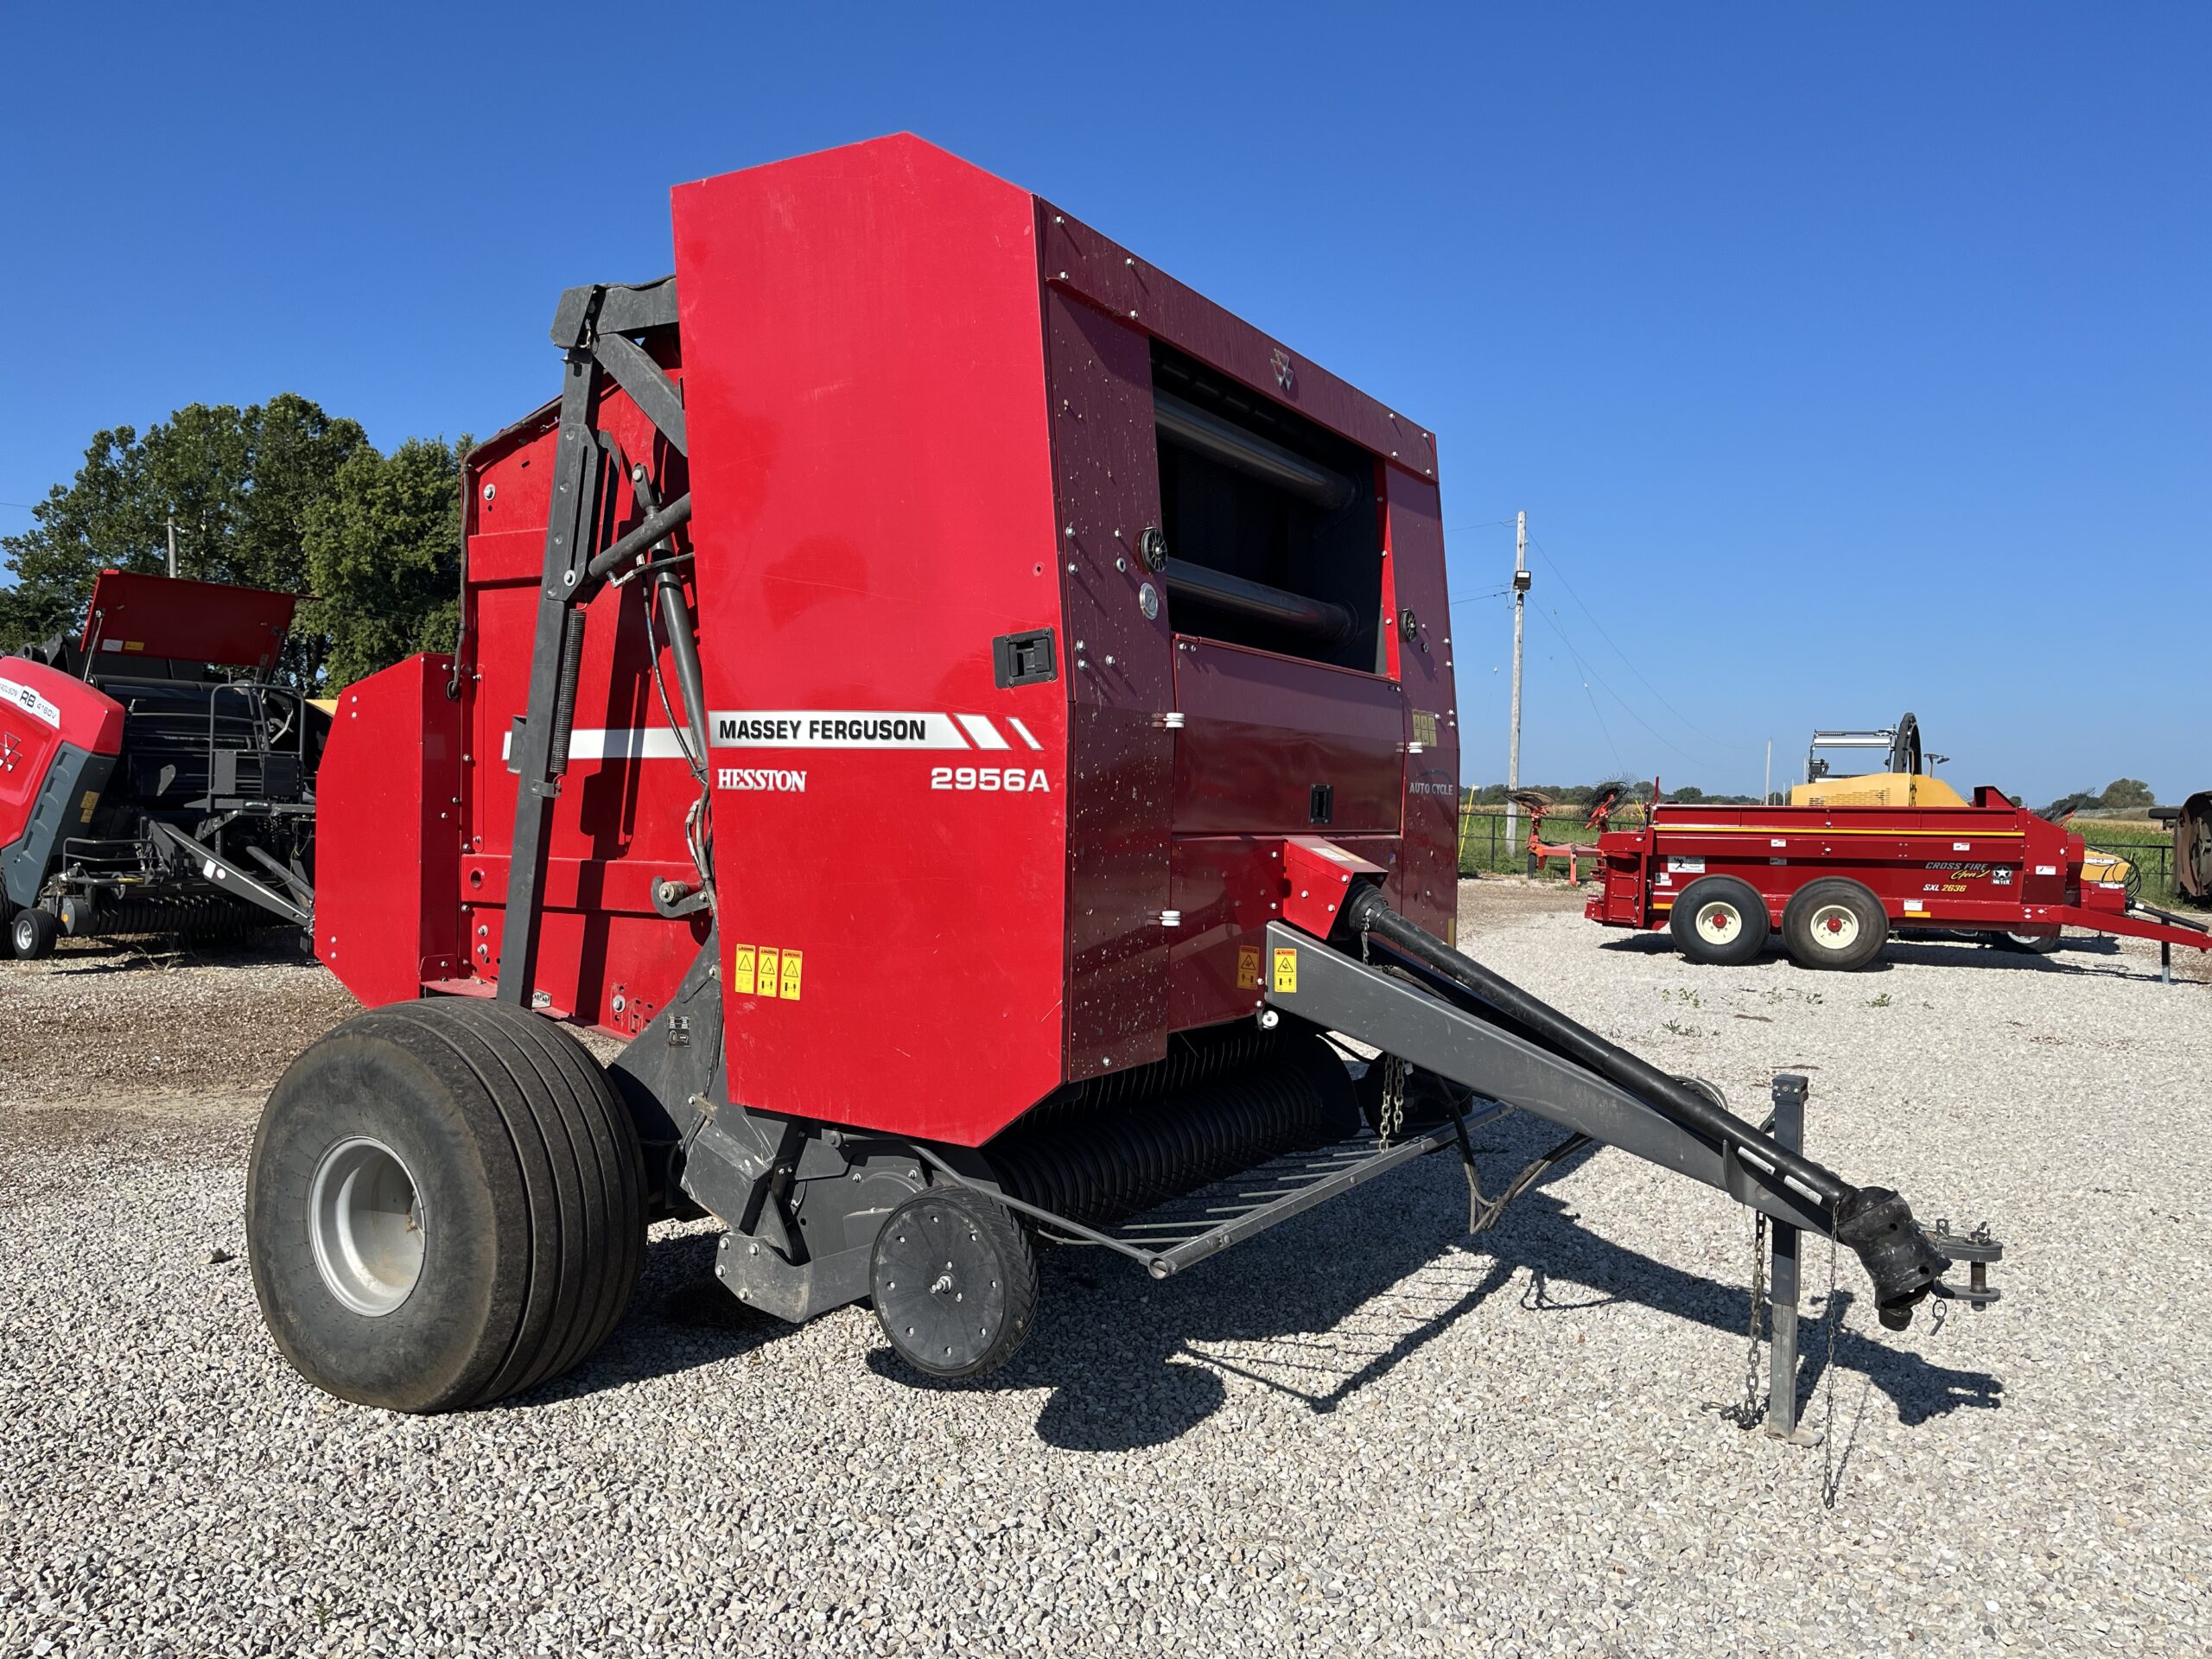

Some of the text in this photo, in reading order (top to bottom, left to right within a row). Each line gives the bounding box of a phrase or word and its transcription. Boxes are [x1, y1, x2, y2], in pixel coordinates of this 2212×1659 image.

[20, 690, 36, 708] RB
[720, 720, 925, 741] MASSEY FERGUSON
[717, 768, 807, 792] HESSTON
[931, 767, 1051, 792] 2956A
[1409, 782, 1453, 795] AUTO CYCLE
